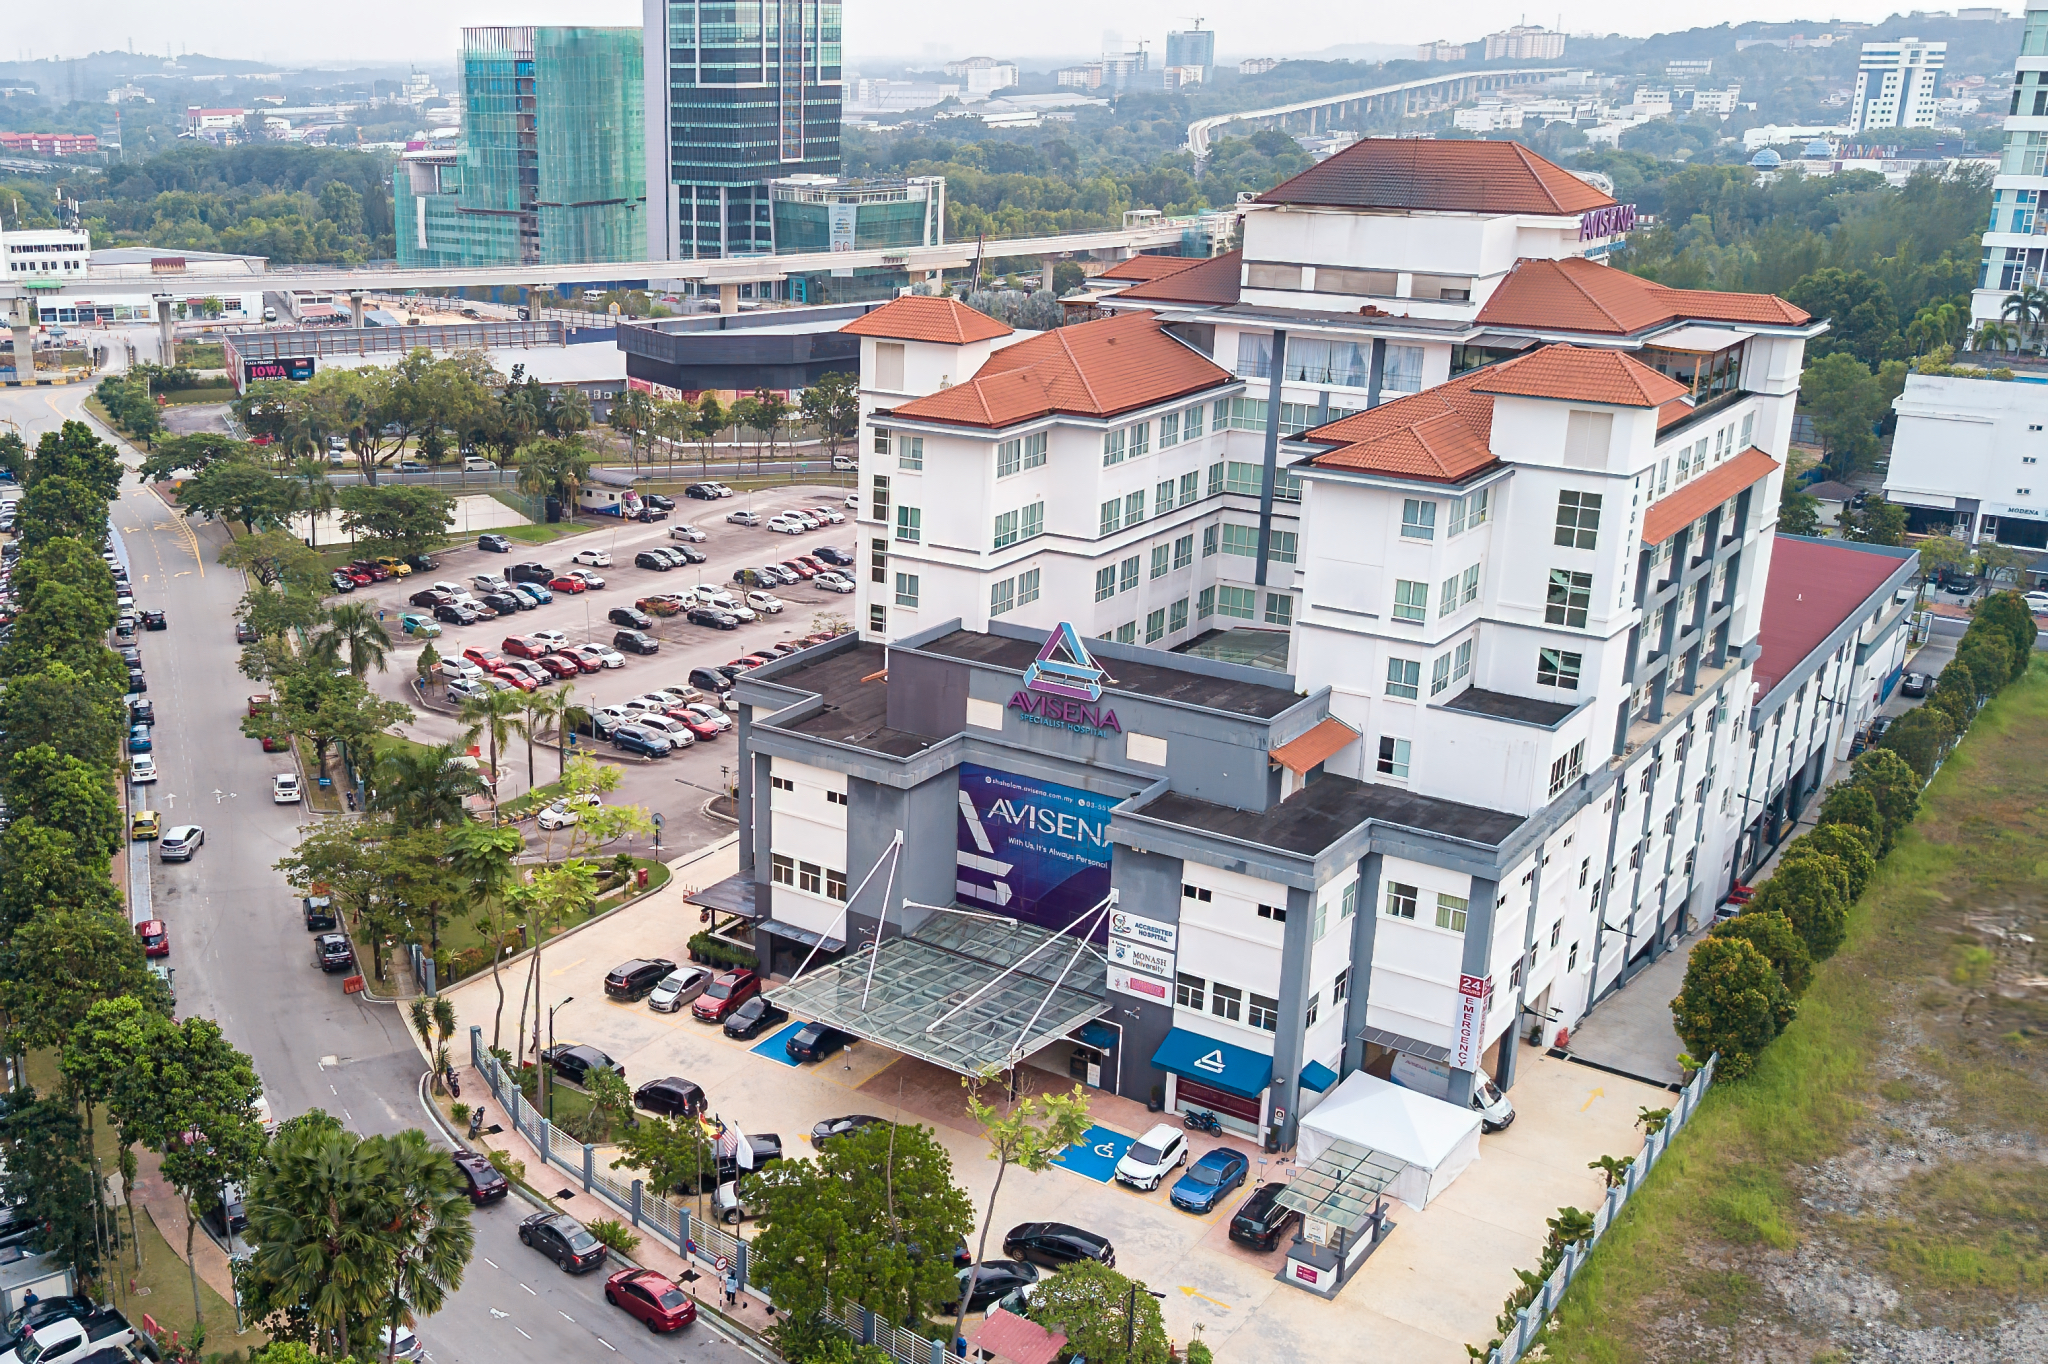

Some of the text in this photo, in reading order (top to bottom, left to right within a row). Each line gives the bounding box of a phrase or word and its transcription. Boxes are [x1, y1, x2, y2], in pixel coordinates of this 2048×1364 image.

[1579, 203, 1636, 243] AVISENA
[251, 365, 286, 376] IOWA
[2007, 507, 2039, 516] MODENA
[1006, 690, 1122, 734] AVISENA
[1020, 713, 1108, 739] SPECIALIST HOSPITAL
[987, 798, 1113, 848] AVISEN
[1008, 836, 1109, 870] With Us, It's Always Personal
[1134, 922, 1174, 938] ACCREDITED
[1138, 929, 1169, 943] HOSPITAL
[1132, 950, 1168, 967] MONASH
[1132, 957, 1165, 975] University
[1460, 987, 1481, 996] HOURS
[1461, 977, 1481, 991] 24
[1458, 996, 1474, 1067] EMERGENCY
